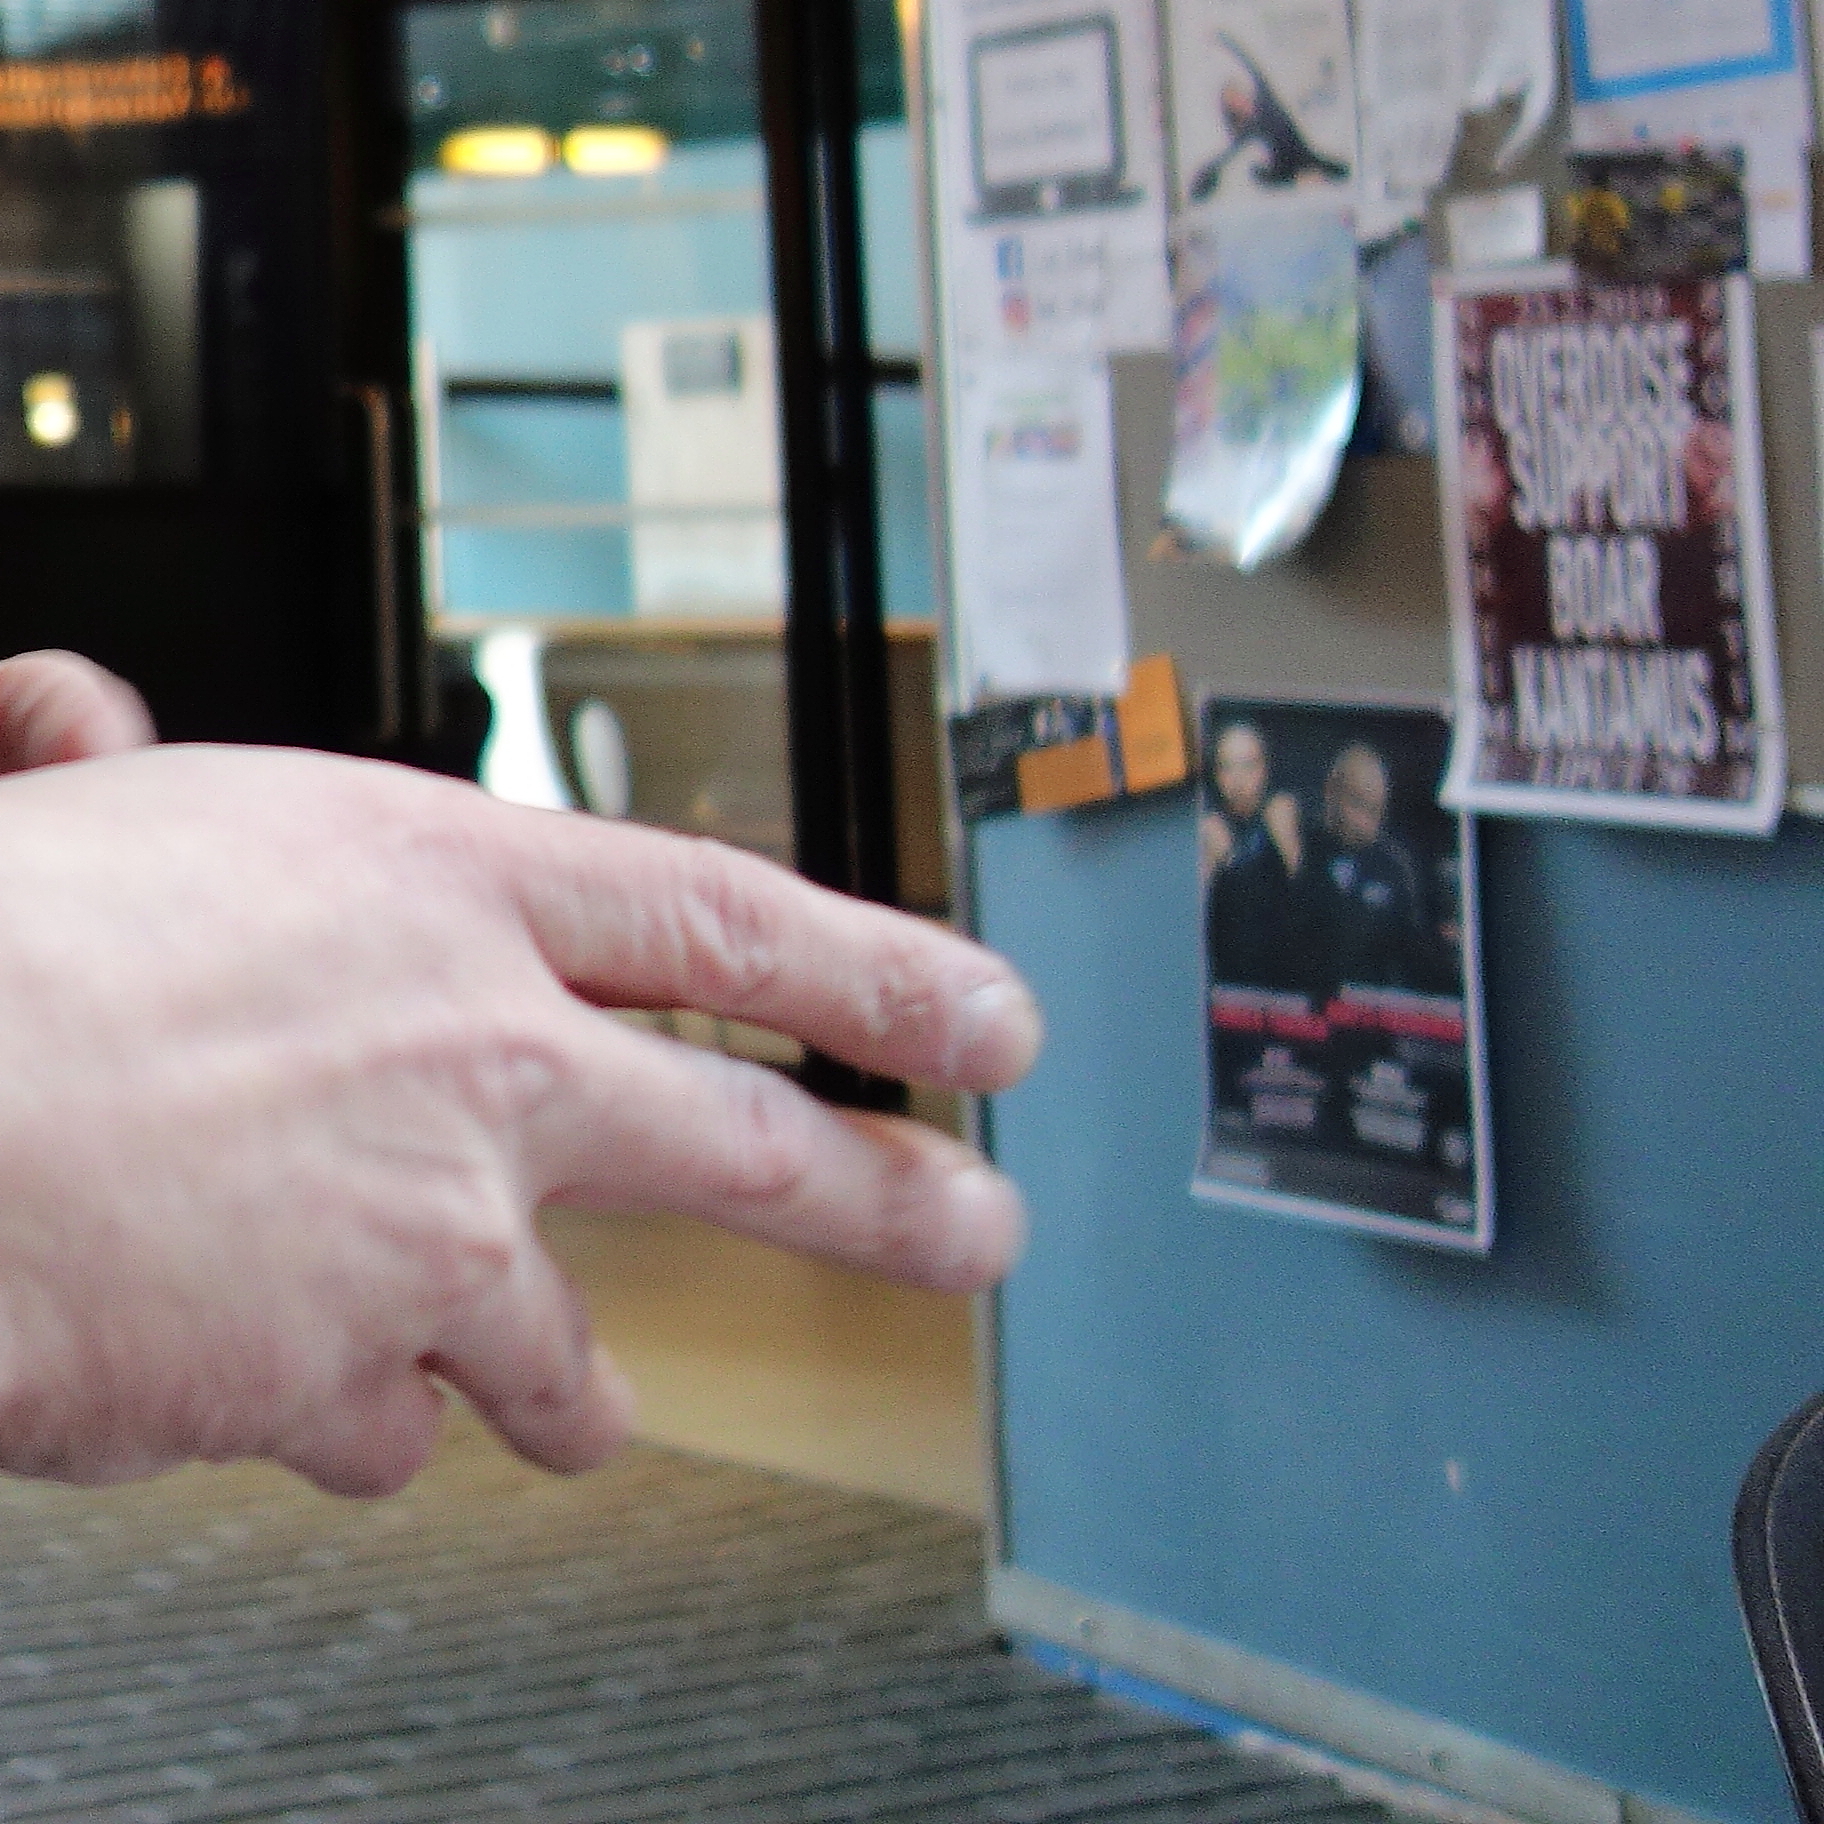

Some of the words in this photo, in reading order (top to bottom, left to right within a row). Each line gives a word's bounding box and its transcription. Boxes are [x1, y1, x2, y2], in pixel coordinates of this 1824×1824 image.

[1491, 319, 1694, 434] OVERDOSE
[1508, 423, 1691, 534] SUPPORT
[1547, 534, 1663, 643] BOAR
